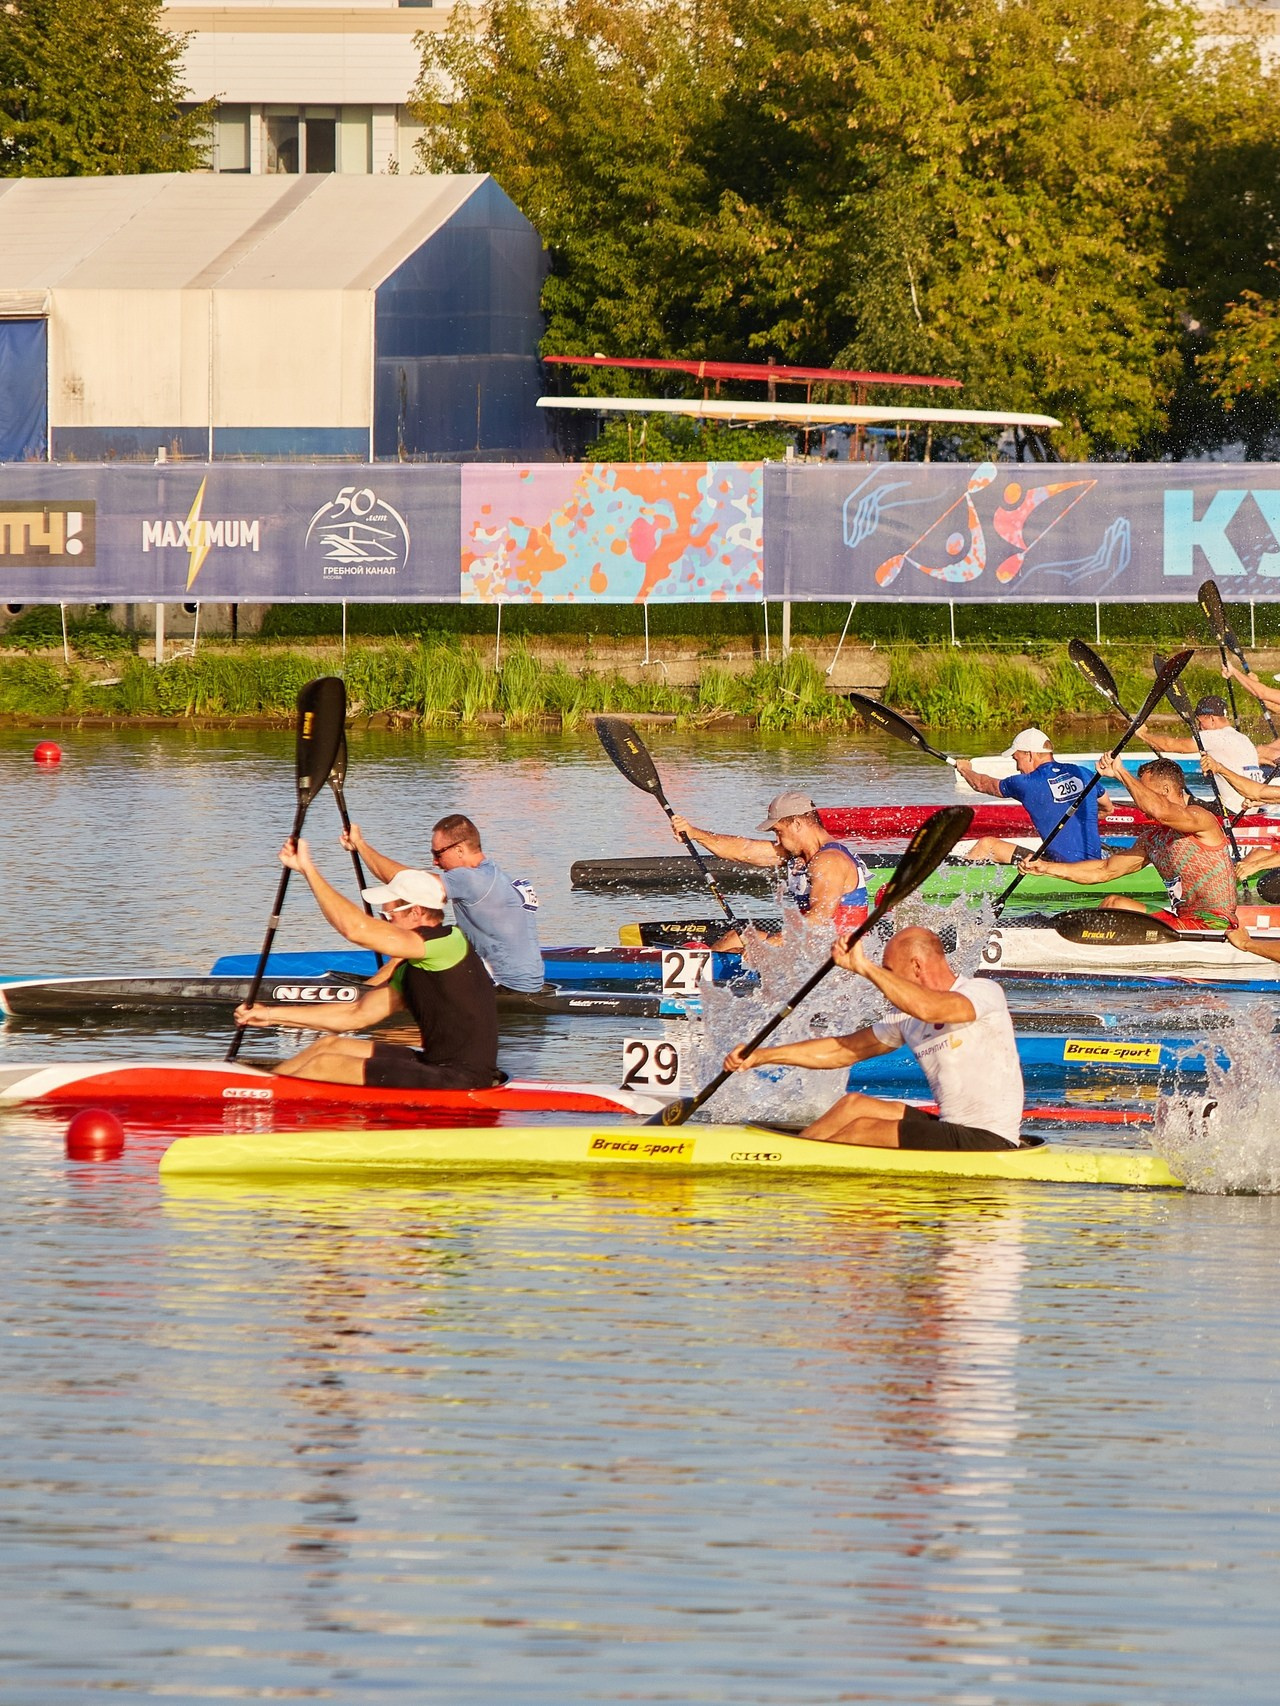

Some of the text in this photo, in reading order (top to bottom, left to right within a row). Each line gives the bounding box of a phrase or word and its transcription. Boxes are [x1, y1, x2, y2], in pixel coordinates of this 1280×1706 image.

[330, 486, 376, 519] 50
[0, 511, 83, 555] ТЧ!
[142, 519, 260, 552] MAXIMUM
[323, 565, 396, 575] ГРЕБНОЙ КАНАЛ
[1057, 780, 1077, 796] 296
[1106, 931, 1116, 939] IV
[664, 952, 710, 989] 27
[276, 987, 356, 1001] NELO
[624, 1041, 678, 1086] 29
[224, 1089, 270, 1098] NELO
[731, 1152, 781, 1161] NELO
